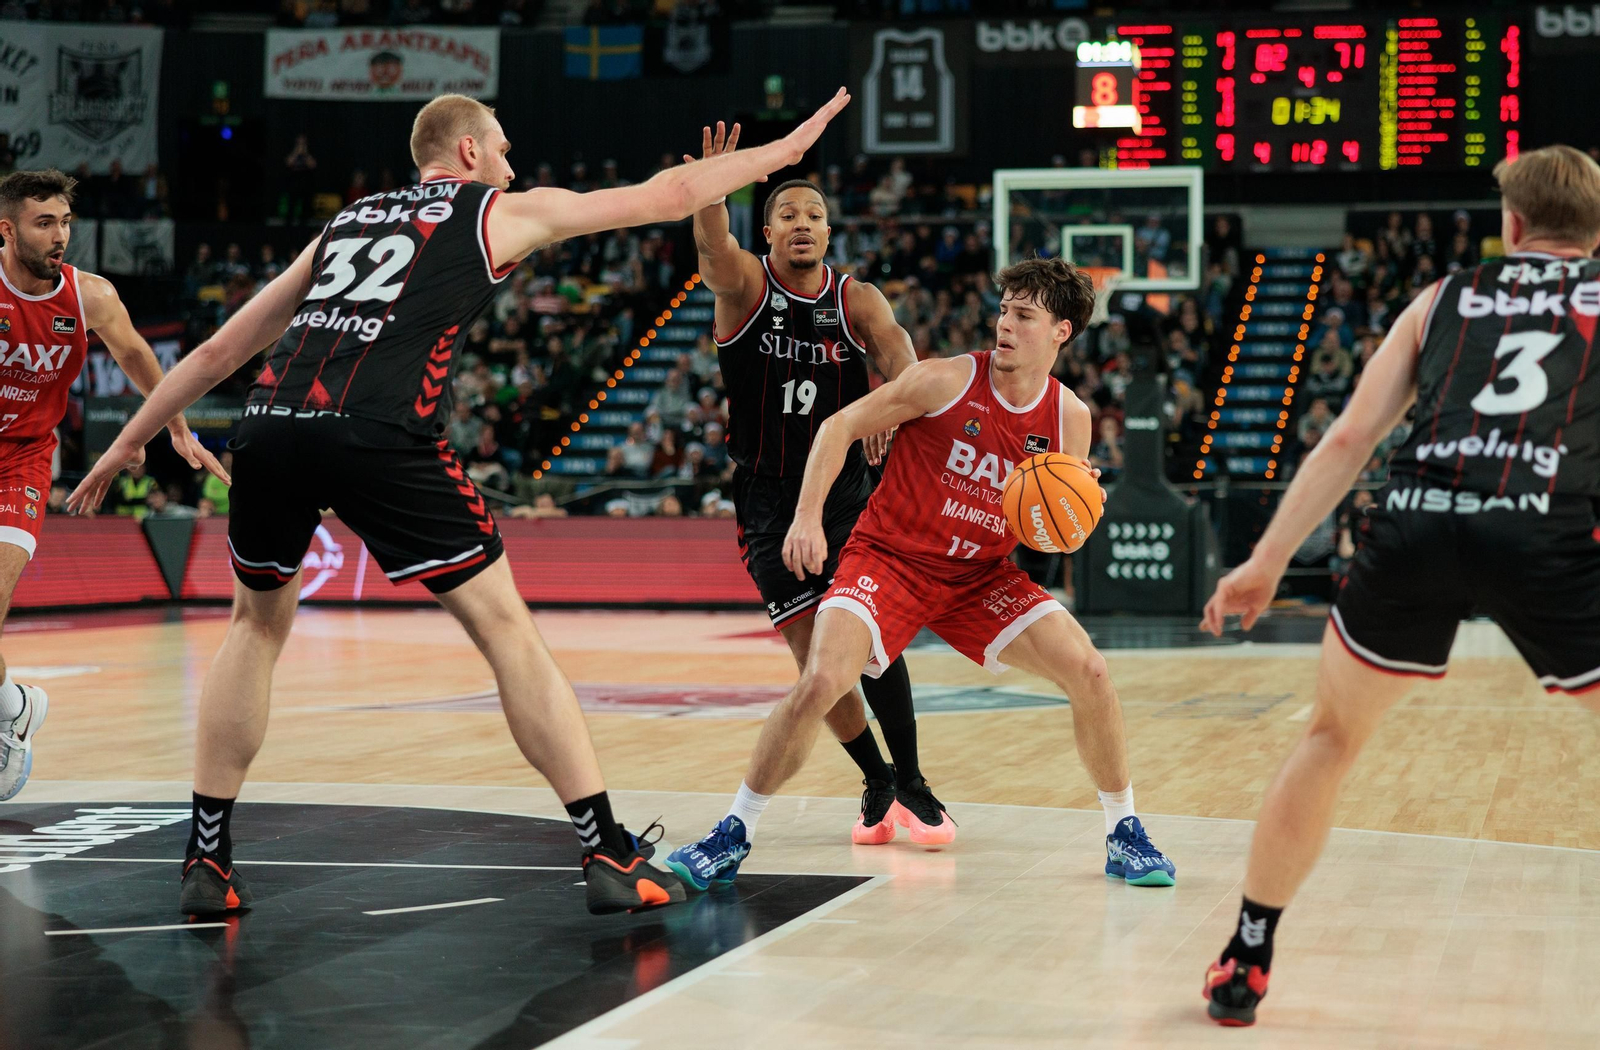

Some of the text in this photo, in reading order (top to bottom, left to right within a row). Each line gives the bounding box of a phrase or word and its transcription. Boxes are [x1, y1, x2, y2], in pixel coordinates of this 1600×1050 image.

[976, 20, 1059, 51] bbk
[1091, 72, 1118, 106] 8
[331, 204, 415, 228] bbk
[305, 234, 415, 302] 32
[1457, 286, 1566, 317] bbk
[759, 332, 850, 365] surne
[1470, 330, 1565, 416] 3
[781, 379, 818, 415] 19
[946, 438, 1014, 492] BAX
[941, 472, 1003, 506] CLIMATIZA
[1387, 487, 1549, 515] NISSAN
[941, 497, 1007, 538] MANRESA
[946, 535, 981, 560] 17
[987, 594, 1017, 615] ETL
[1000, 591, 1044, 621] GLOBAL
